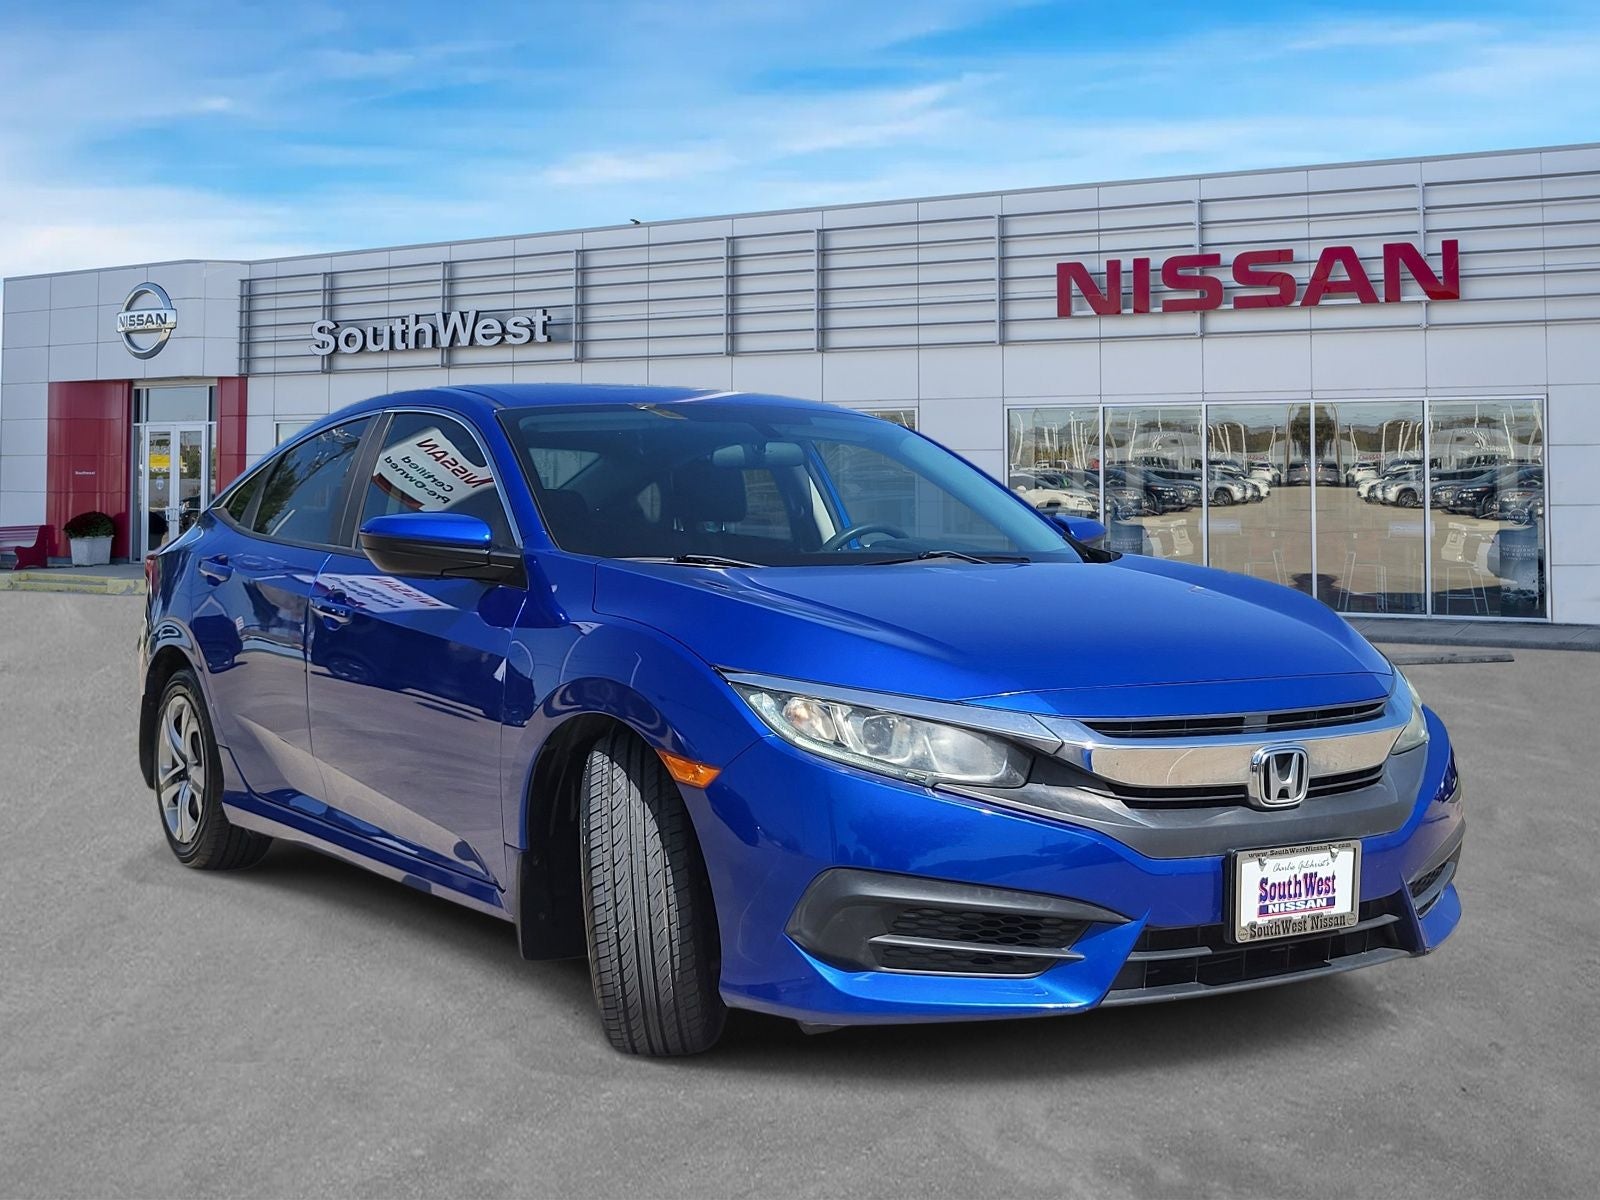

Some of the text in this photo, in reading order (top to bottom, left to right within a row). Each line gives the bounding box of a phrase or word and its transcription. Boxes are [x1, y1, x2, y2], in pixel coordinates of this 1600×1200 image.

[1057, 239, 1460, 318] NISSAN
[118, 312, 168, 329] NISSAN
[309, 309, 551, 356] SouthWest
[1268, 897, 1328, 914] NISSAN
[1249, 914, 1347, 939] SouthWest Nissan
